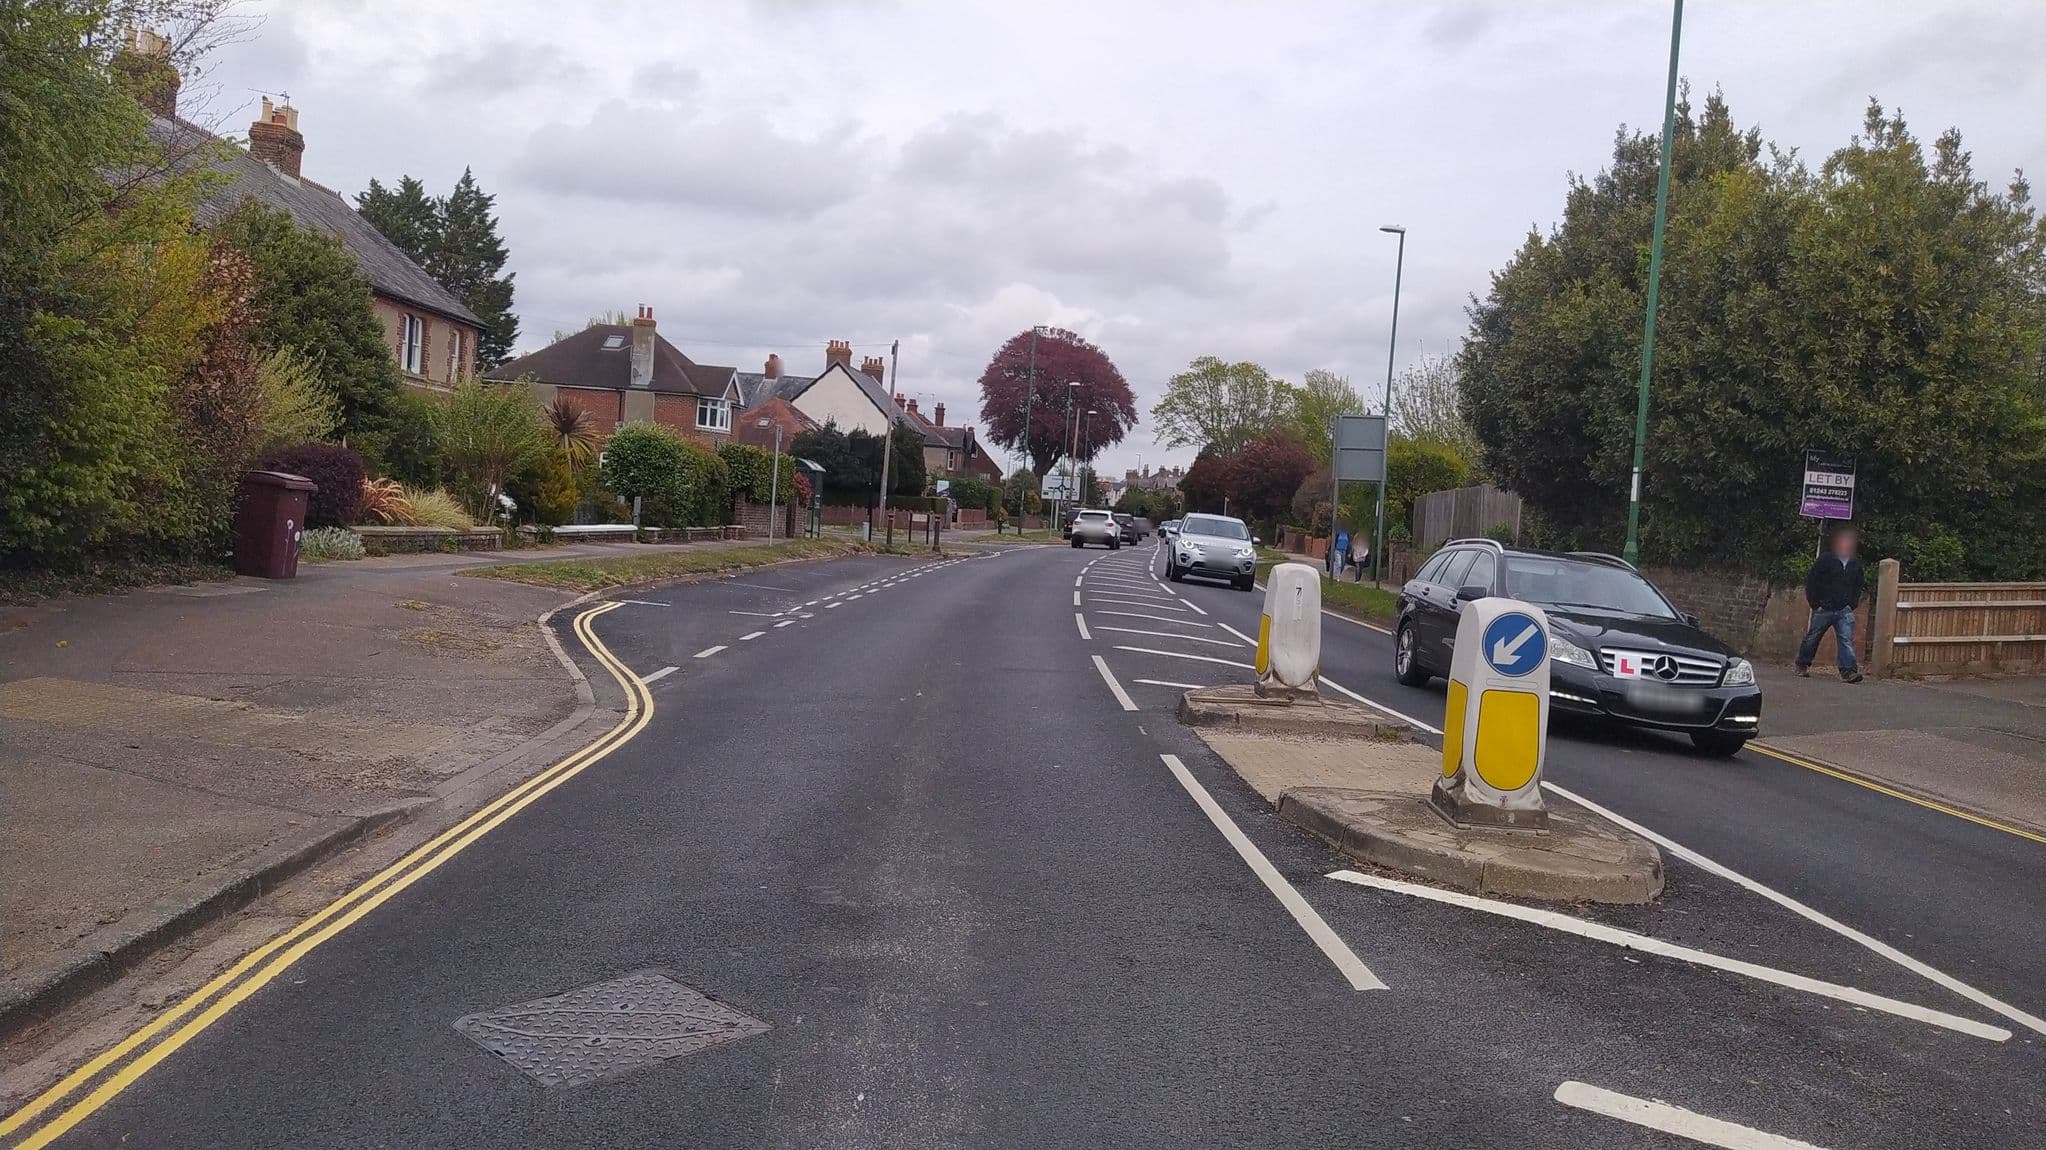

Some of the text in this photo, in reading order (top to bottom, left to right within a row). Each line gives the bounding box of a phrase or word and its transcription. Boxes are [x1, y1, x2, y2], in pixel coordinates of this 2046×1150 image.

[1809, 473, 1850, 485] LET BY
[1296, 587, 1302, 596] 7
[1621, 659, 1634, 674] L
